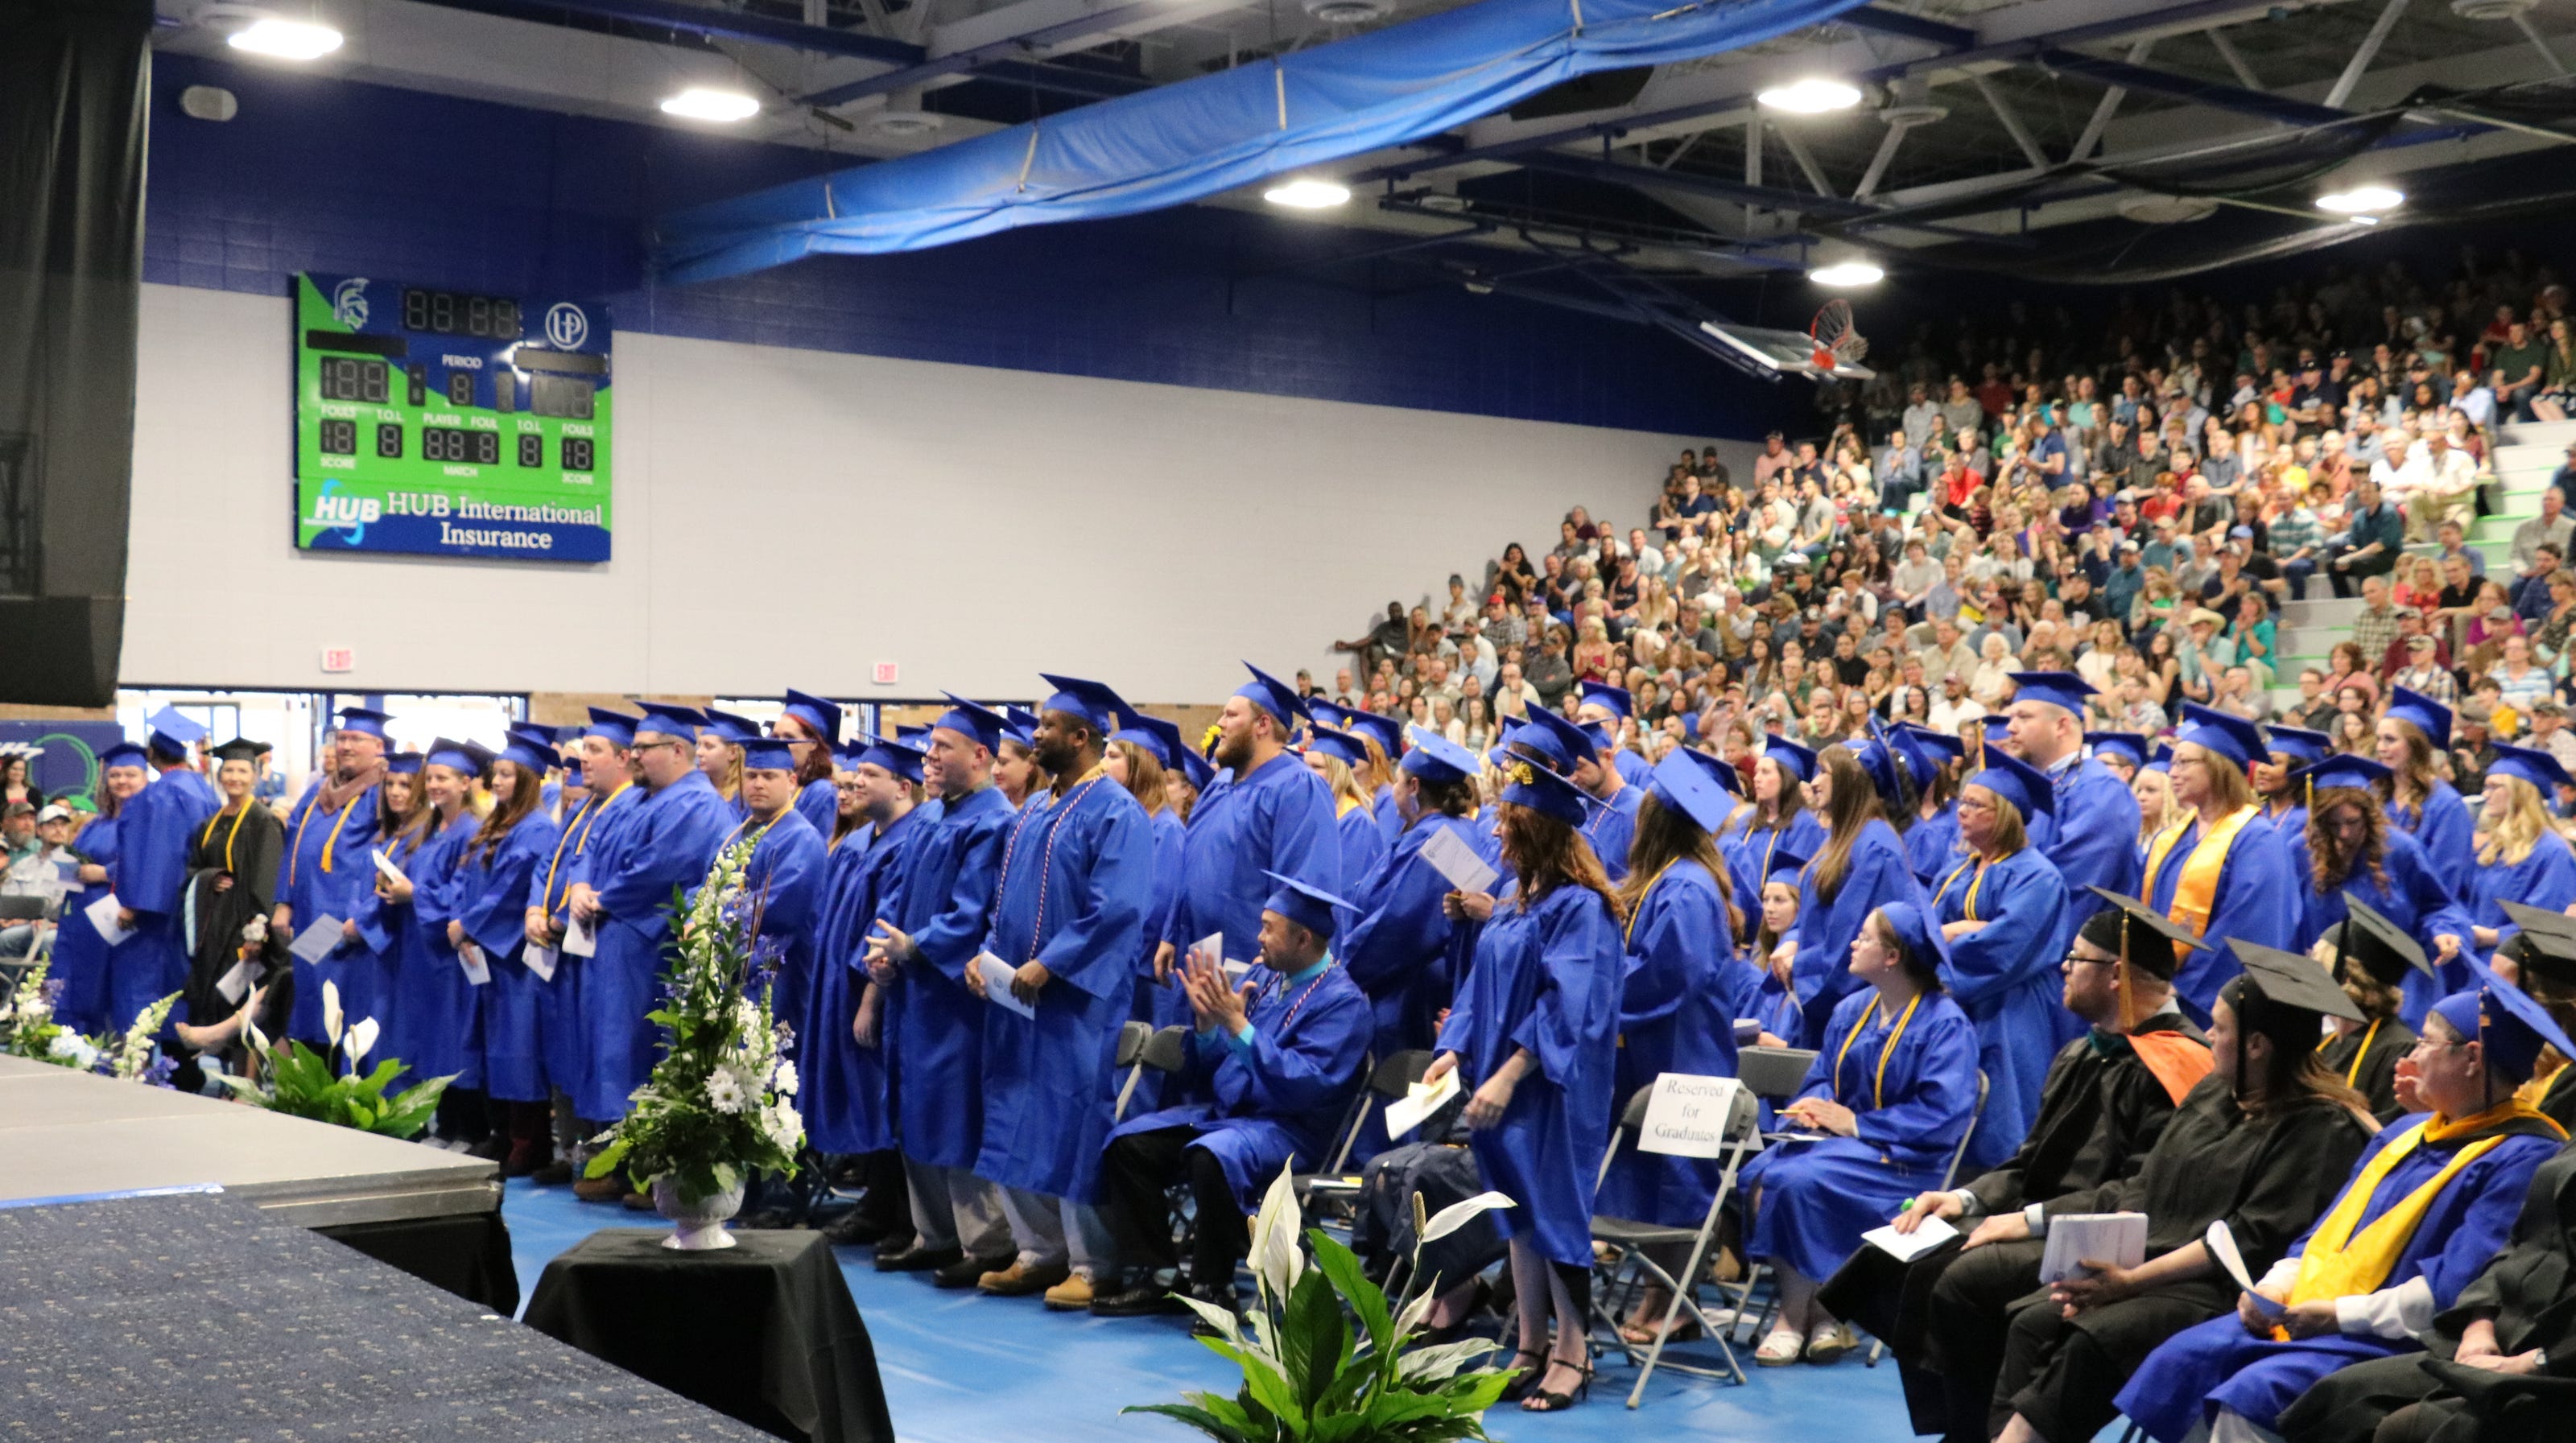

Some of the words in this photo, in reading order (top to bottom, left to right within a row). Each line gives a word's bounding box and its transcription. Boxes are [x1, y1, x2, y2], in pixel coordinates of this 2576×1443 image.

[442, 354, 482, 369] PERIOD
[321, 404, 356, 418] FOULS
[423, 413, 462, 427] PLAYER
[471, 416, 497, 428] FOUL
[562, 423, 593, 436] FOULS
[320, 457, 356, 471] SCORE
[444, 466, 478, 477] MATCH
[562, 472, 593, 484] SCORE
[315, 496, 381, 522] HUB
[387, 493, 451, 515] HUB
[460, 497, 602, 526] International
[440, 522, 553, 549] Insurance
[1667, 1079, 1724, 1096] Reserved
[1682, 1103, 1700, 1119] for
[1655, 1122, 1715, 1141] Graduates
